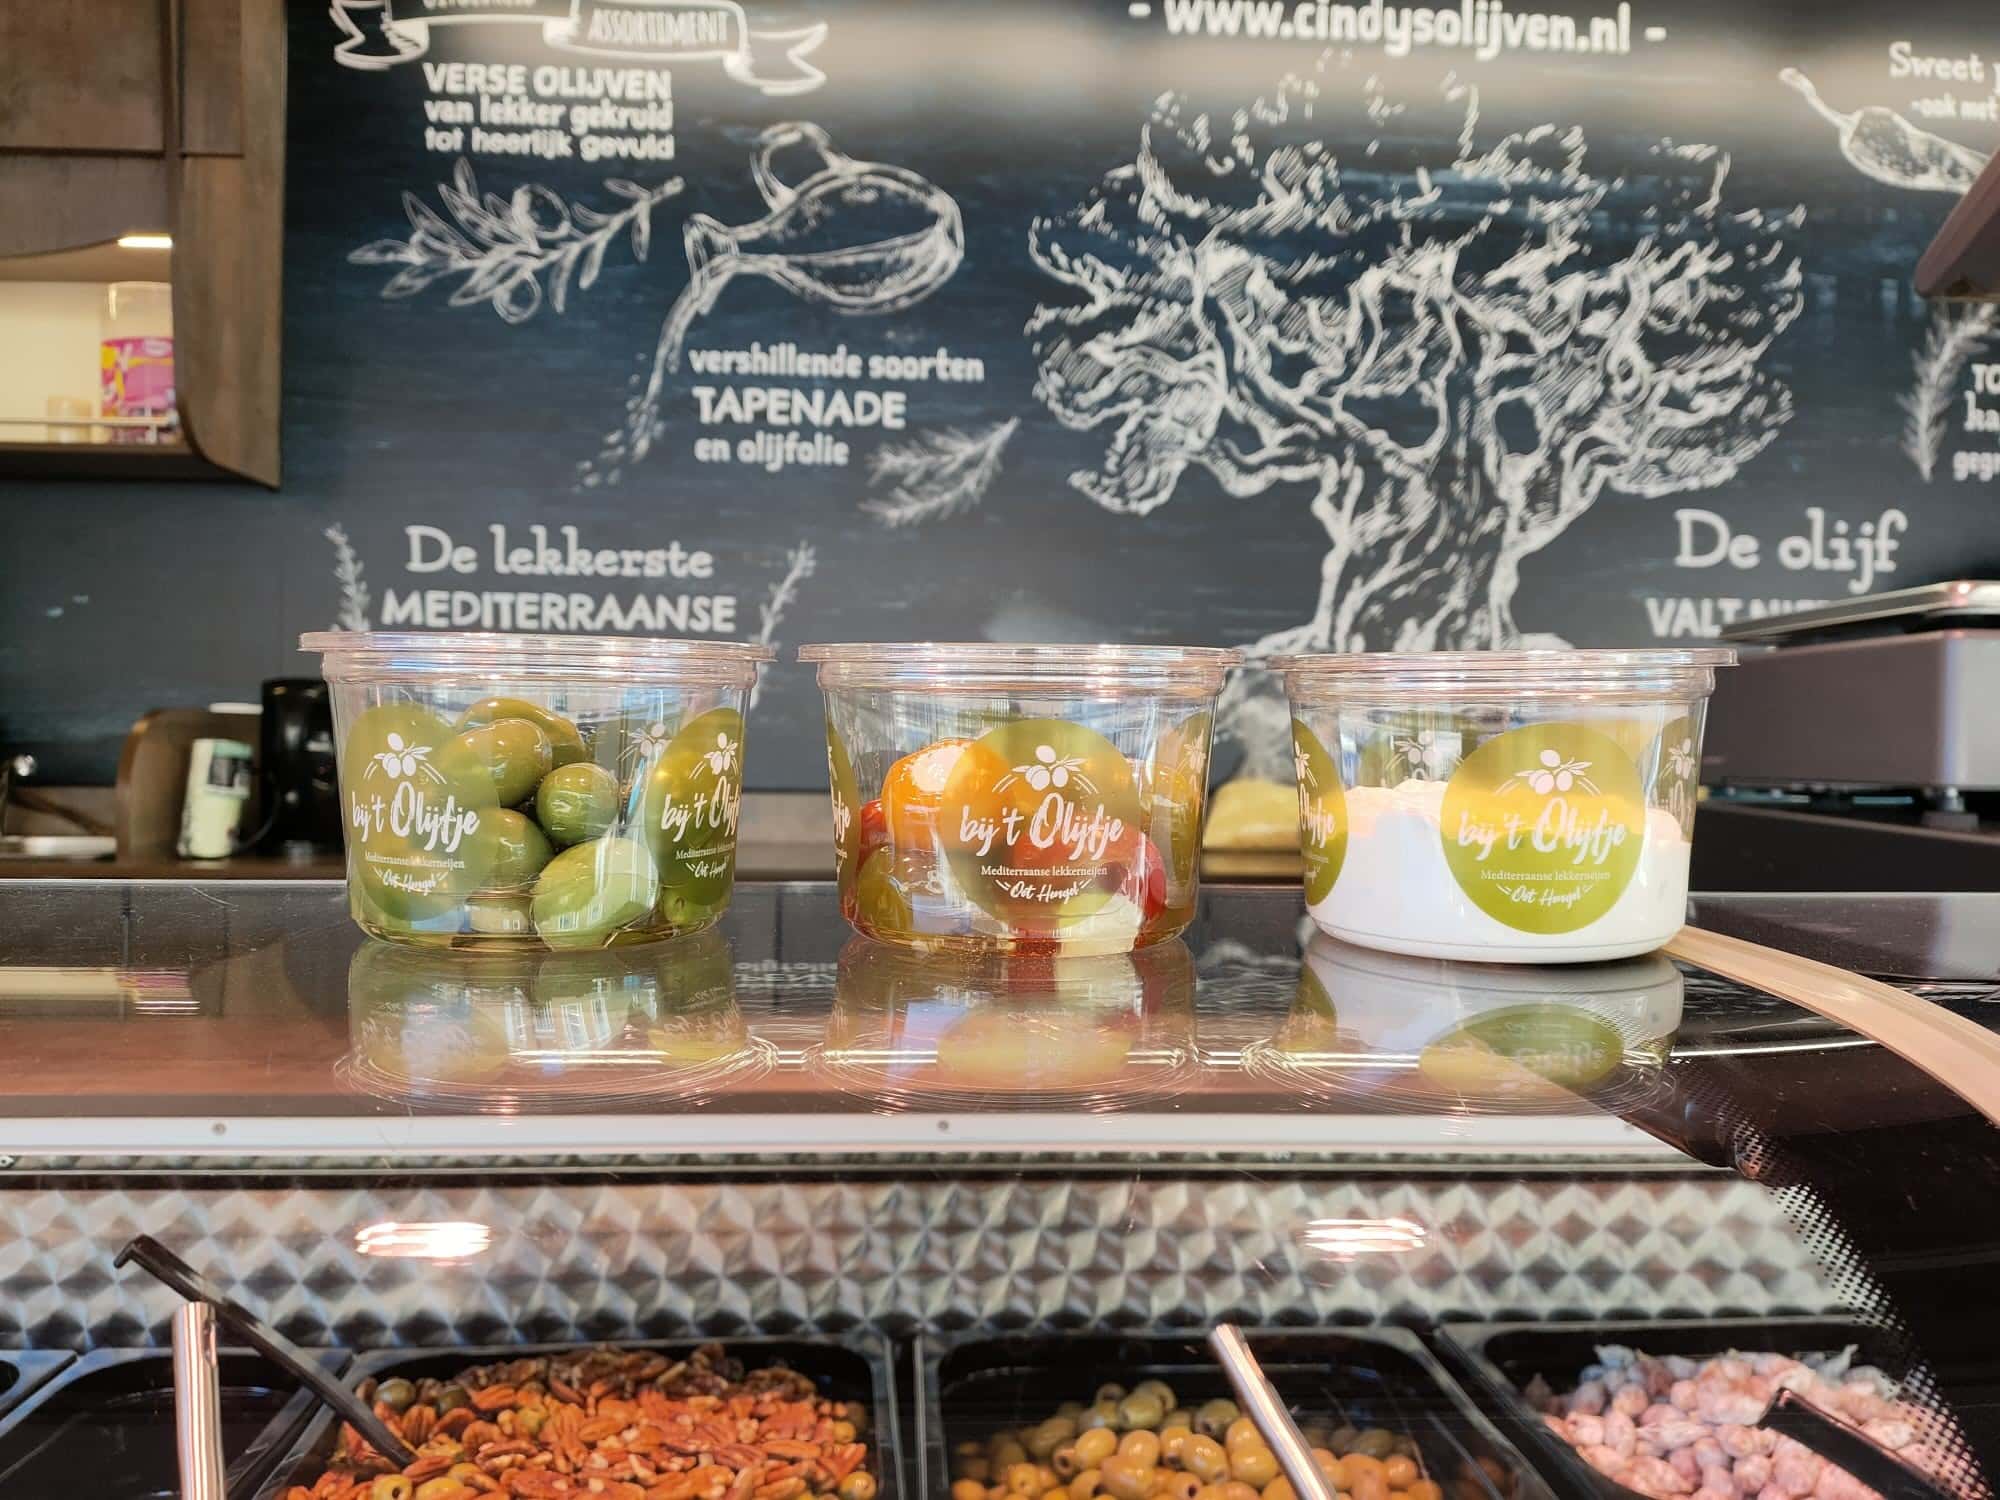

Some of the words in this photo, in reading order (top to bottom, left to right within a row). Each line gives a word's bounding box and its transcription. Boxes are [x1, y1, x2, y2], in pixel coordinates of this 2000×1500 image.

[1163, 0, 1631, 60] www.cindysolijven.nl
[422, 63, 527, 94] VERSE
[533, 66, 672, 99] OLIJVEN
[1889, 40, 1984, 82] Sweet
[424, 101, 474, 124] van
[480, 95, 566, 125] lekker
[570, 99, 674, 136] gekruid
[425, 127, 464, 152] tot
[471, 127, 573, 159] heerlijk
[579, 134, 675, 162] gevuld
[689, 342, 862, 378] vershillende
[869, 347, 984, 381] soorten
[692, 386, 907, 429] TAPENADE
[694, 436, 731, 463] en
[737, 430, 849, 473] olijfolie
[405, 525, 477, 574] De
[489, 525, 713, 578] lekkerste
[1674, 508, 1760, 569] De
[1778, 507, 1908, 594] olijf
[382, 589, 736, 633] MEDITERRAANSE
[1645, 598, 1742, 638] VALT
[390, 781, 480, 853] Olijfje
[661, 794, 692, 843] bij
[956, 804, 1000, 857] bij
[1029, 792, 1124, 860] Olijfje
[1457, 810, 1500, 861] bij
[1532, 797, 1627, 865] Olijfje
[981, 865, 1051, 877] Mediterraanse
